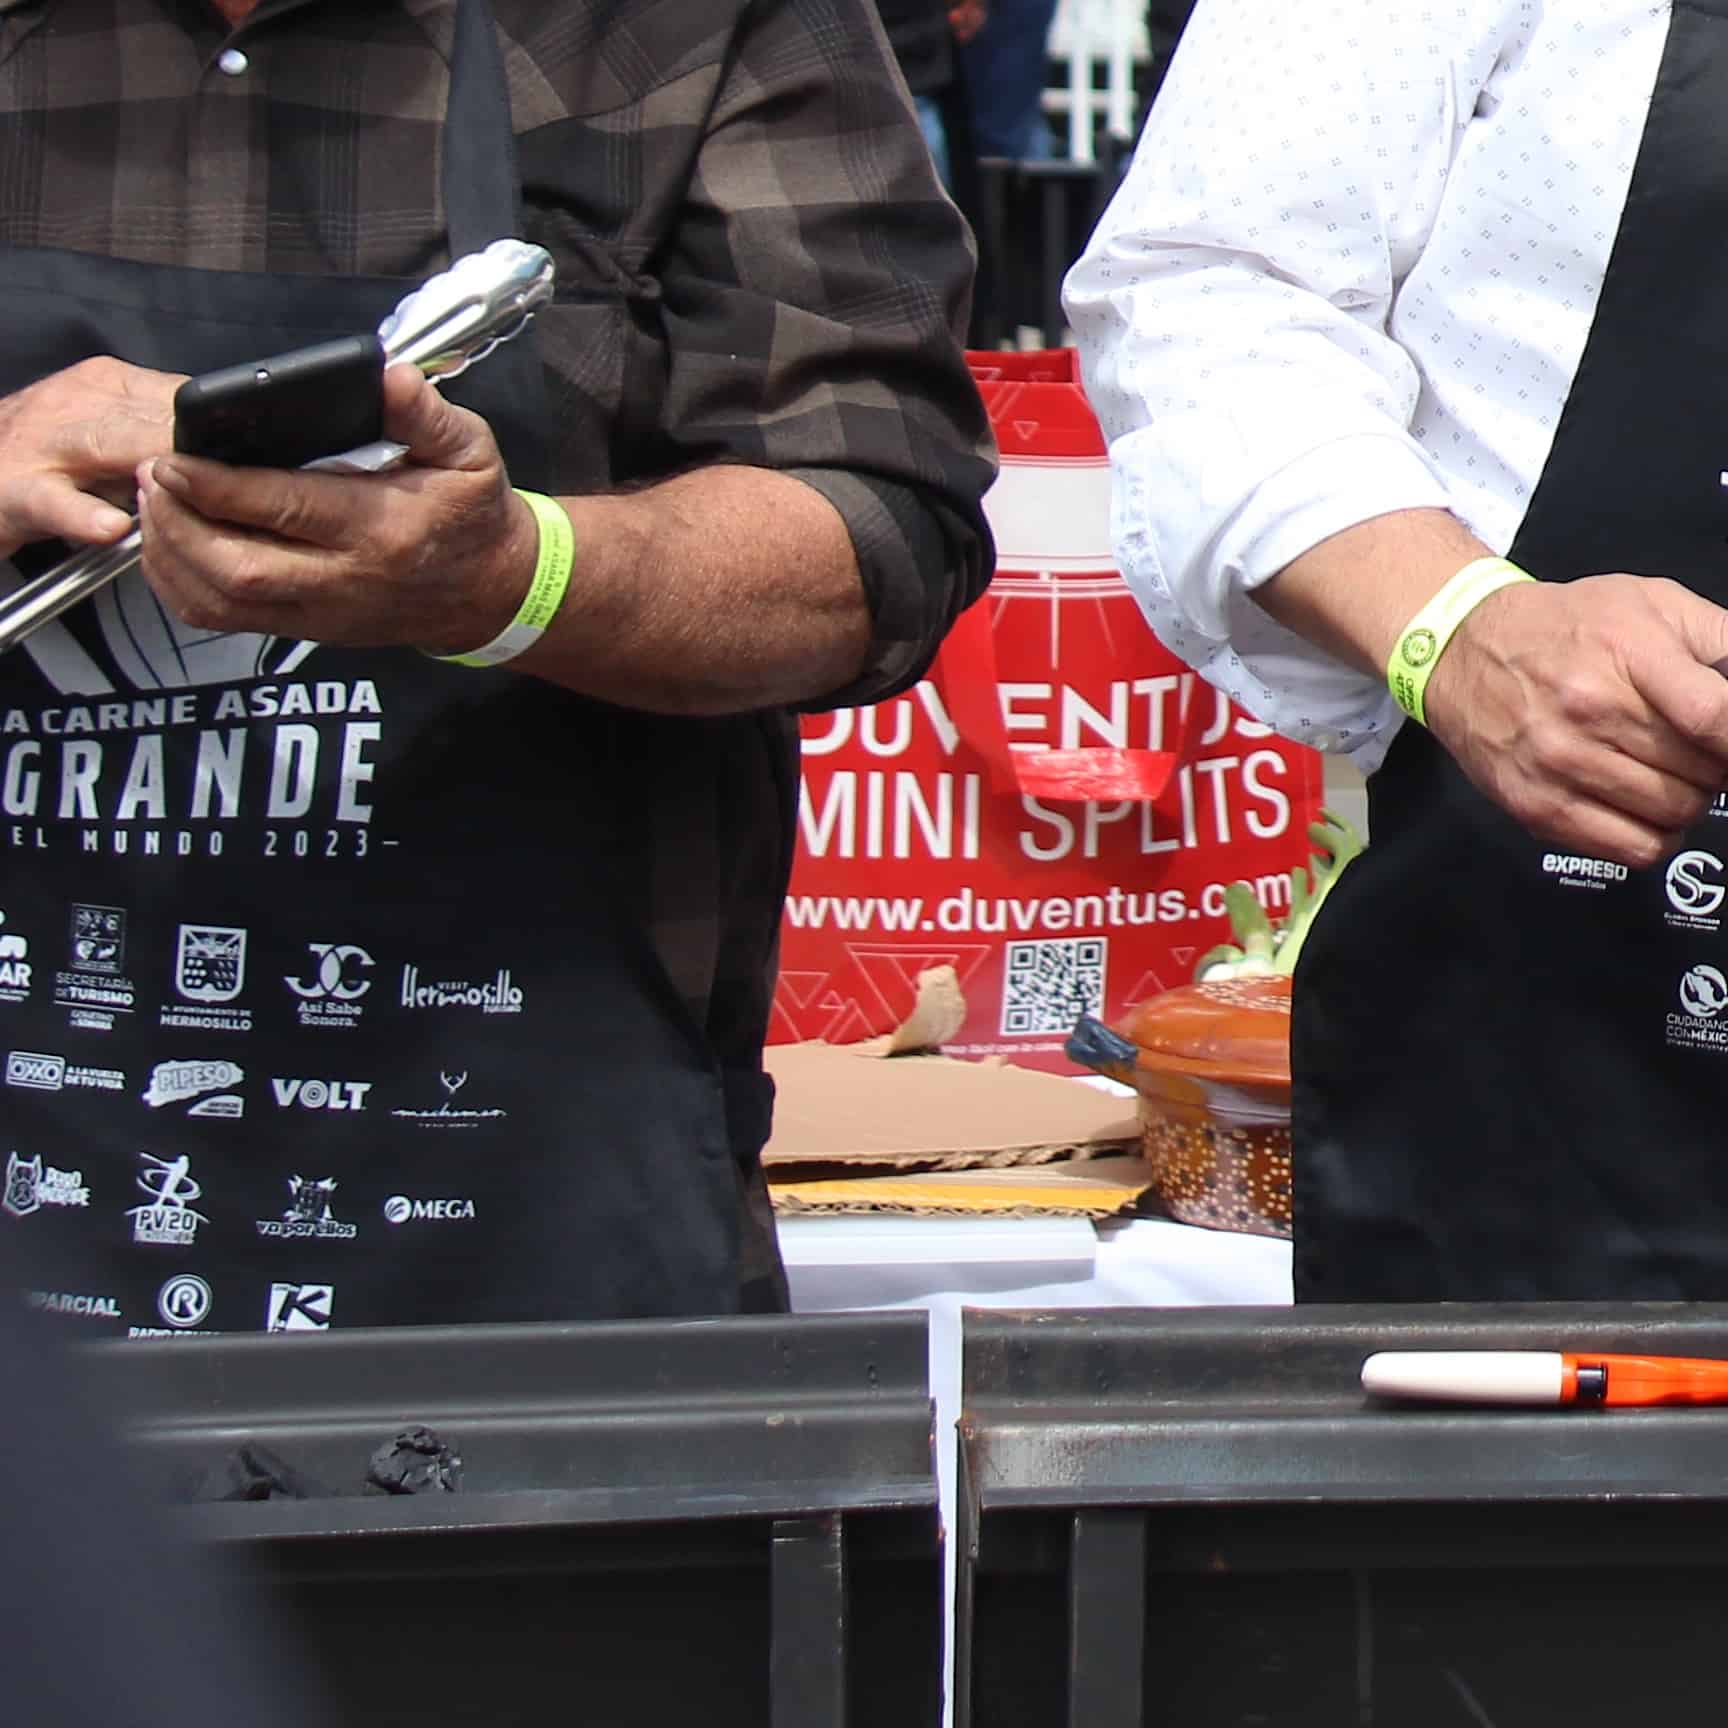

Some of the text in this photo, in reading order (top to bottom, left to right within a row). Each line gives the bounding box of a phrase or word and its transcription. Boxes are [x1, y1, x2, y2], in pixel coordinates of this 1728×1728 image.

[0, 678, 383, 735] A CARNE ASADA
[1, 720, 382, 824] GRANDE
[798, 748, 1292, 862] MINI SPLITS
[11, 825, 49, 850] EL
[81, 828, 225, 857] MUNDO
[69, 985, 135, 1006] TURISMO
[401, 962, 524, 1008] Hermosillo
[160, 1013, 253, 1031] HERMOSILLO
[325, 1001, 363, 1015] Sabe
[159, 1063, 234, 1092] PIPESO
[411, 1199, 477, 1219] MEGA
[28, 1290, 122, 1317] PARCIAL
